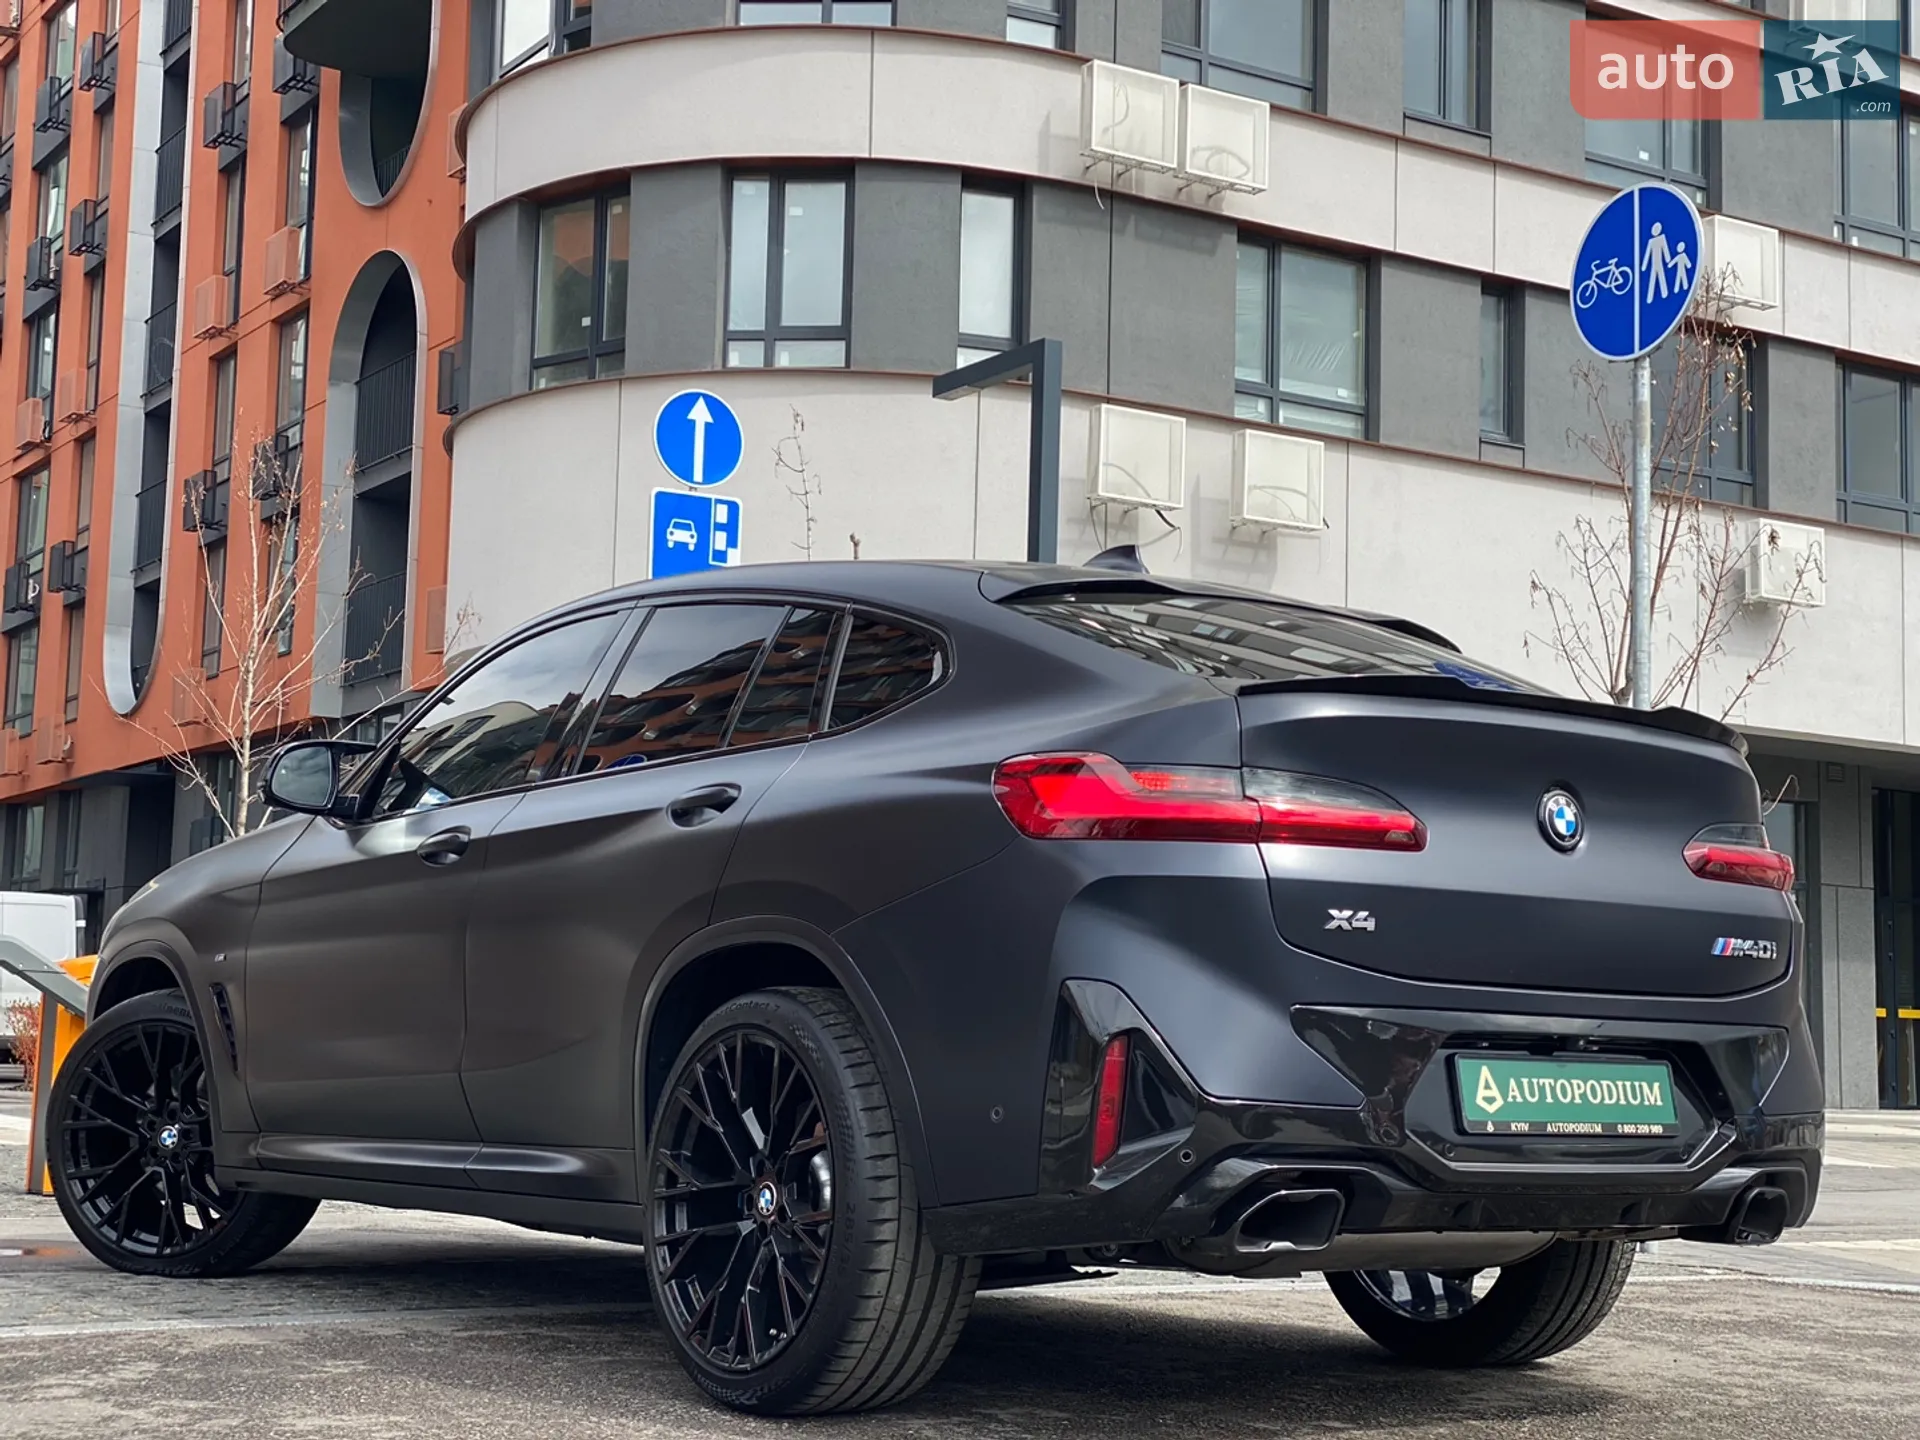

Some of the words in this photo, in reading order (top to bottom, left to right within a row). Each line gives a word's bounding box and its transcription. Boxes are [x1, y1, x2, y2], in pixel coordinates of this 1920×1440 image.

[1324, 909, 1376, 931] X4
[1507, 1078, 1663, 1106] AUTOPODIUM
[1511, 1122, 1529, 1132] KYIV
[1546, 1122, 1602, 1133] AUTOPODIUM
